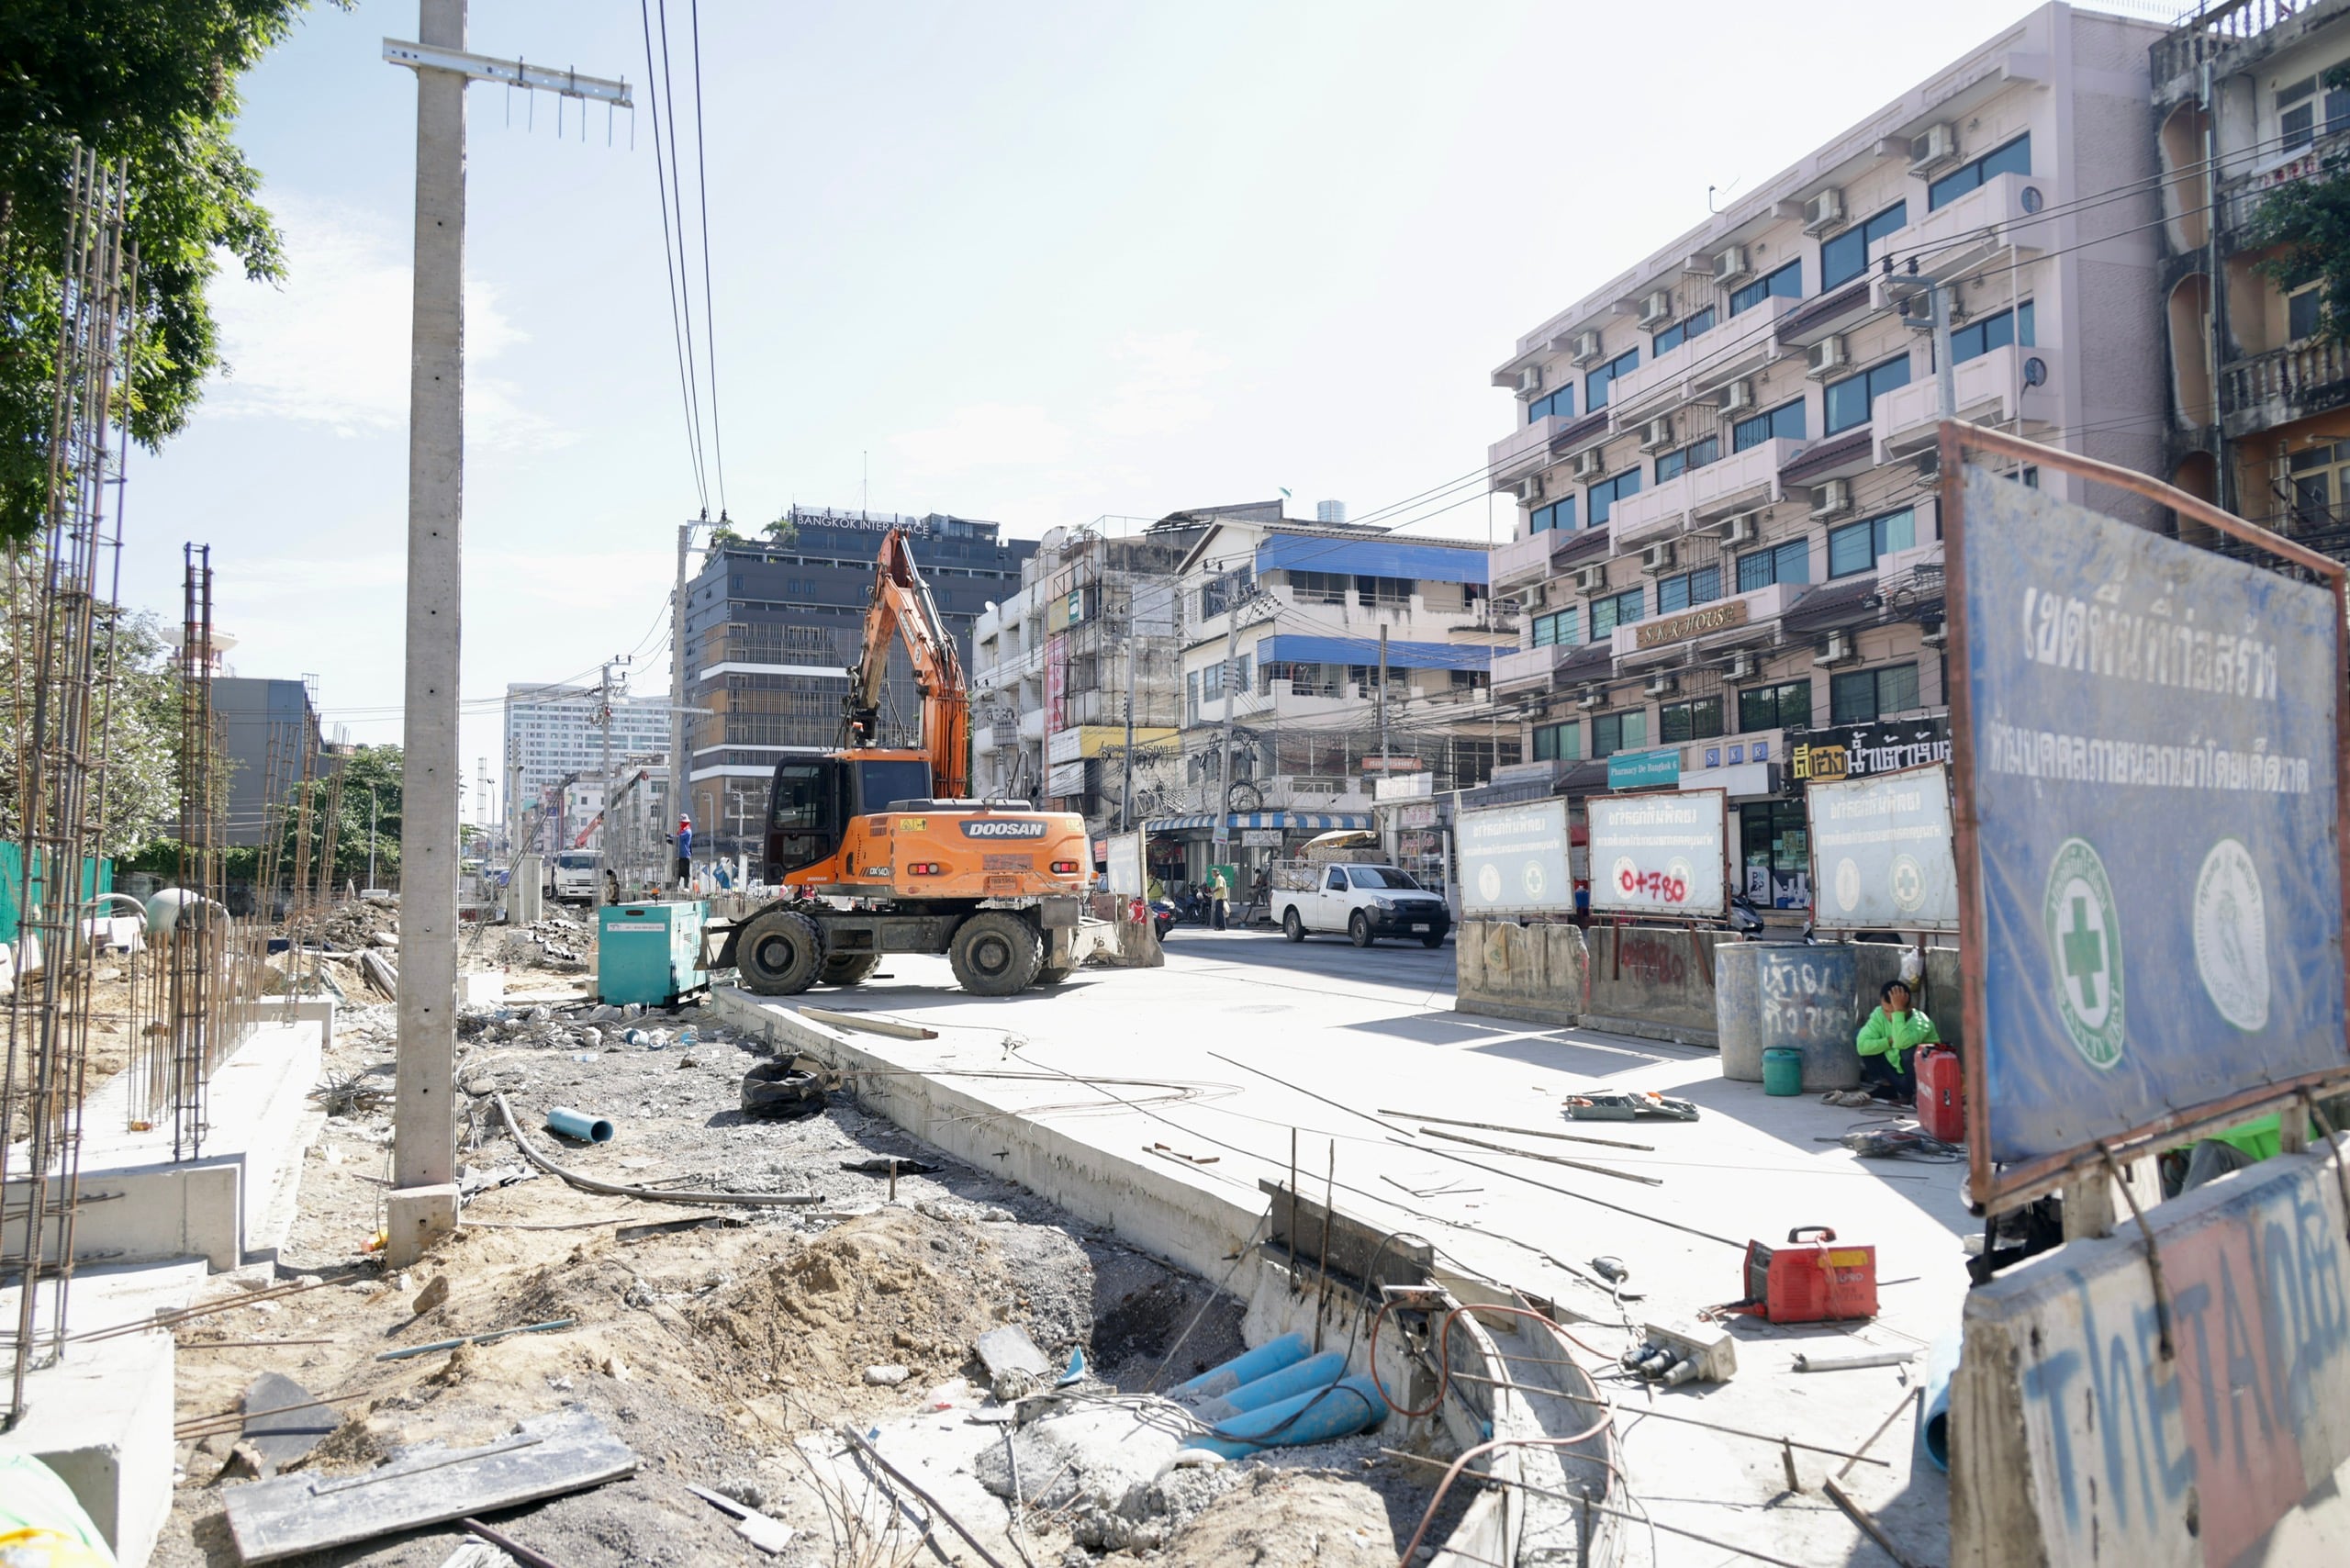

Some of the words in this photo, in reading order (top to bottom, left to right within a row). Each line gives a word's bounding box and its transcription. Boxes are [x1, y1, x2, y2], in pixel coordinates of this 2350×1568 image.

[797, 514, 856, 529] BANGKOK
[859, 521, 890, 532] INTER
[1683, 606, 1736, 633] HOUSE
[2022, 567, 2277, 700] เขตพื้นที่ก่อสร้าง
[1707, 752, 1714, 763] S
[1729, 749, 1737, 760] K
[1754, 746, 1762, 758] R
[1988, 710, 2311, 799] ห้ามบุคคลภายนอกเข้าโดยเด็ดขาด
[1610, 764, 1637, 777] Pharmacy
[1638, 764, 1646, 774] De
[1647, 761, 1672, 775] Bangkok
[1672, 761, 1677, 770] 6
[969, 823, 1043, 836] DOOSAN
[1621, 869, 1685, 903] 0+780
